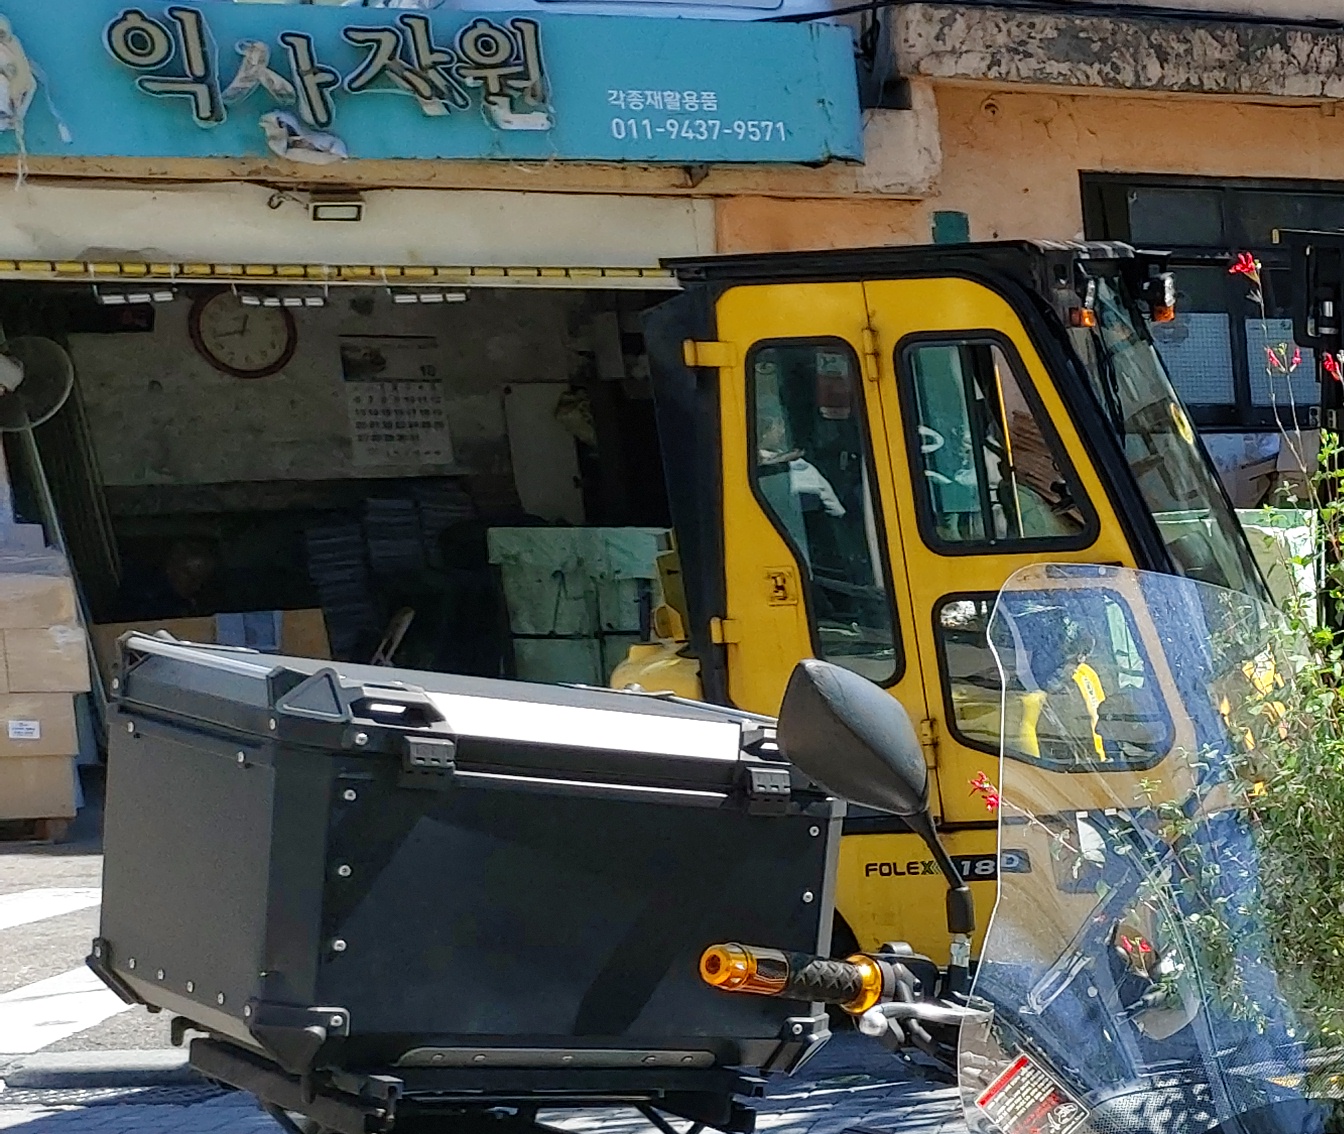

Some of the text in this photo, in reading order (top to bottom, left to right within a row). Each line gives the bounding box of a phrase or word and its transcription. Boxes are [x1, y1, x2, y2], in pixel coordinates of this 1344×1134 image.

[607, 90, 718, 111] 각종재활용품
[611, 118, 786, 141] 011-9437-9571
[865, 861, 935, 877] FOLEX
